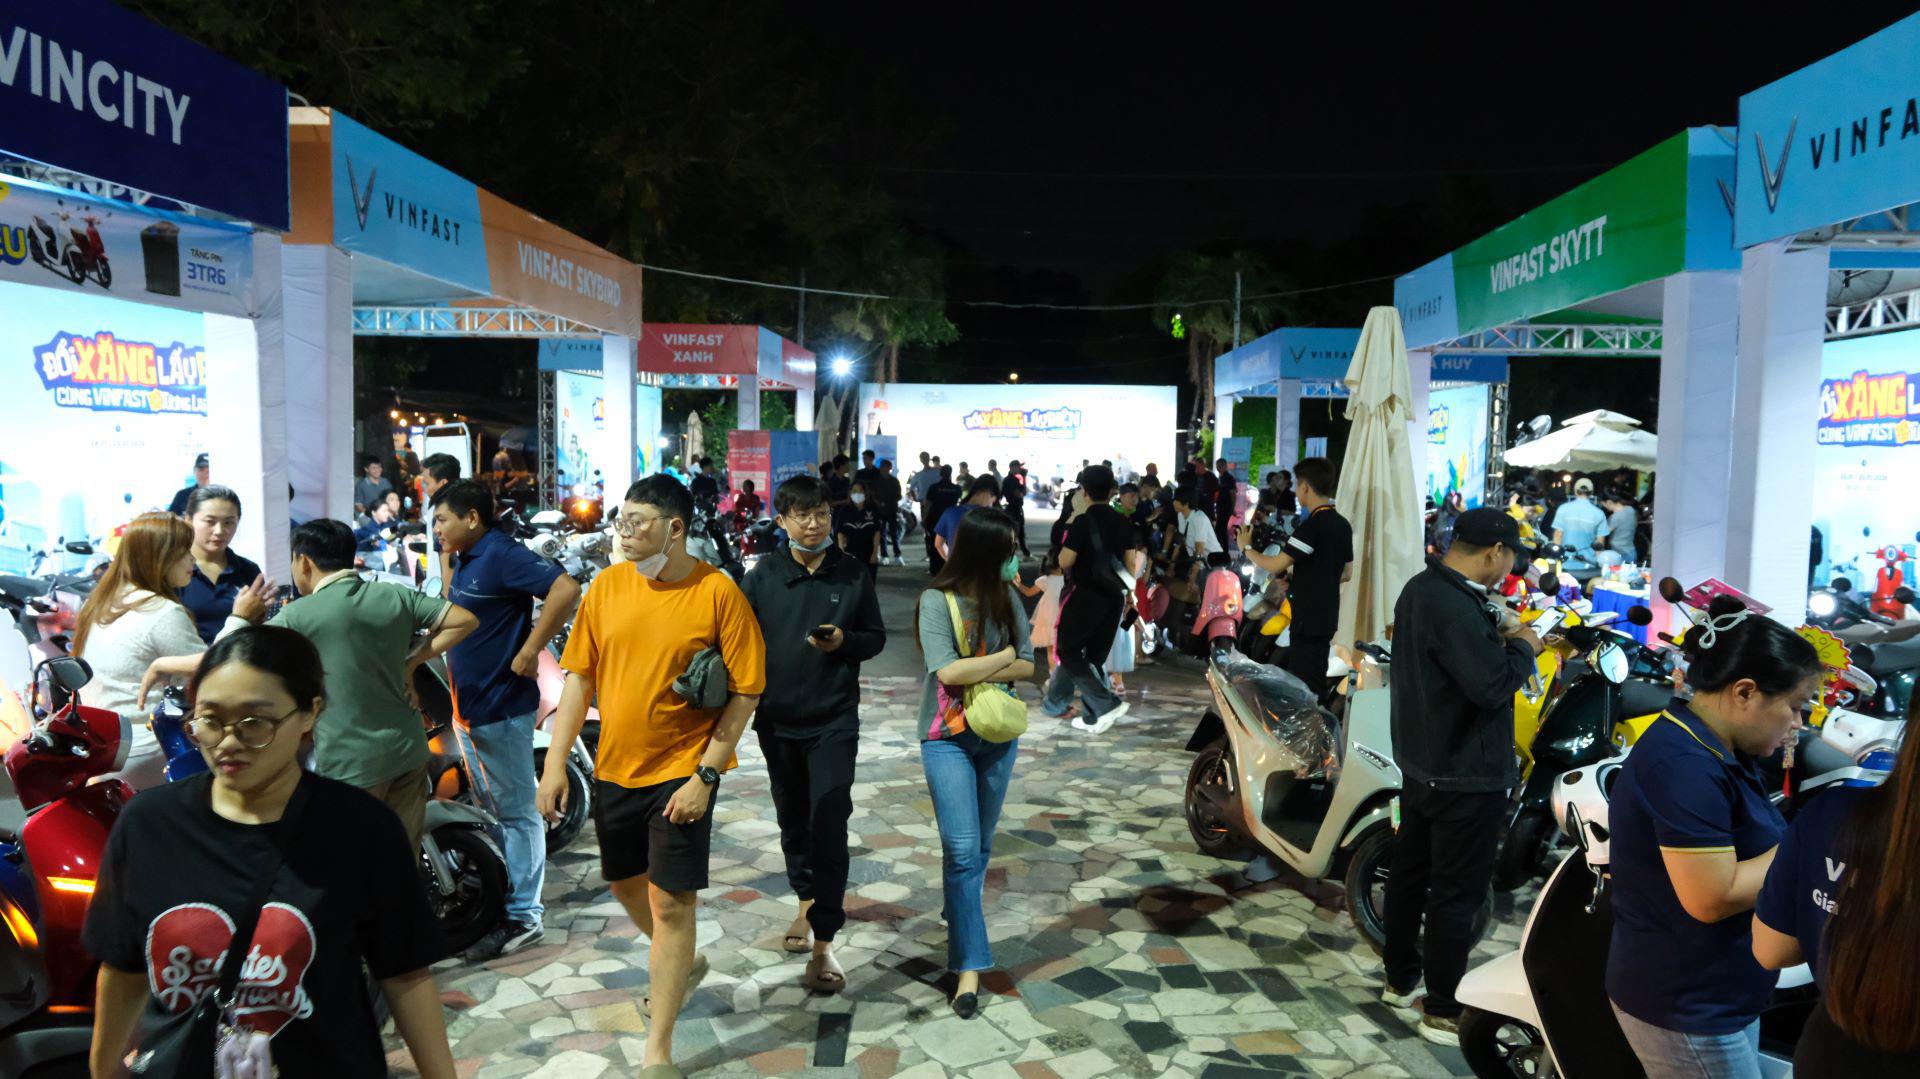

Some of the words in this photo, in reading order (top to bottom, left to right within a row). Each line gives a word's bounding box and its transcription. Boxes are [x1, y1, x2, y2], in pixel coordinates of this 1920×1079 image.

[0, 26, 190, 145] VINCITY
[385, 192, 460, 245] VINFAST
[187, 262, 226, 286] 3TR6
[518, 240, 575, 290] VINFAST
[576, 264, 621, 307] SKYBIRD
[1489, 245, 1546, 295] VINFAST
[1549, 215, 1608, 274] SKYTT
[73, 334, 158, 386] XĂNG
[662, 333, 724, 346] VINFAST
[673, 351, 714, 364] XANH
[1442, 358, 1472, 371] HUY
[1832, 373, 1907, 421] XĂNG
